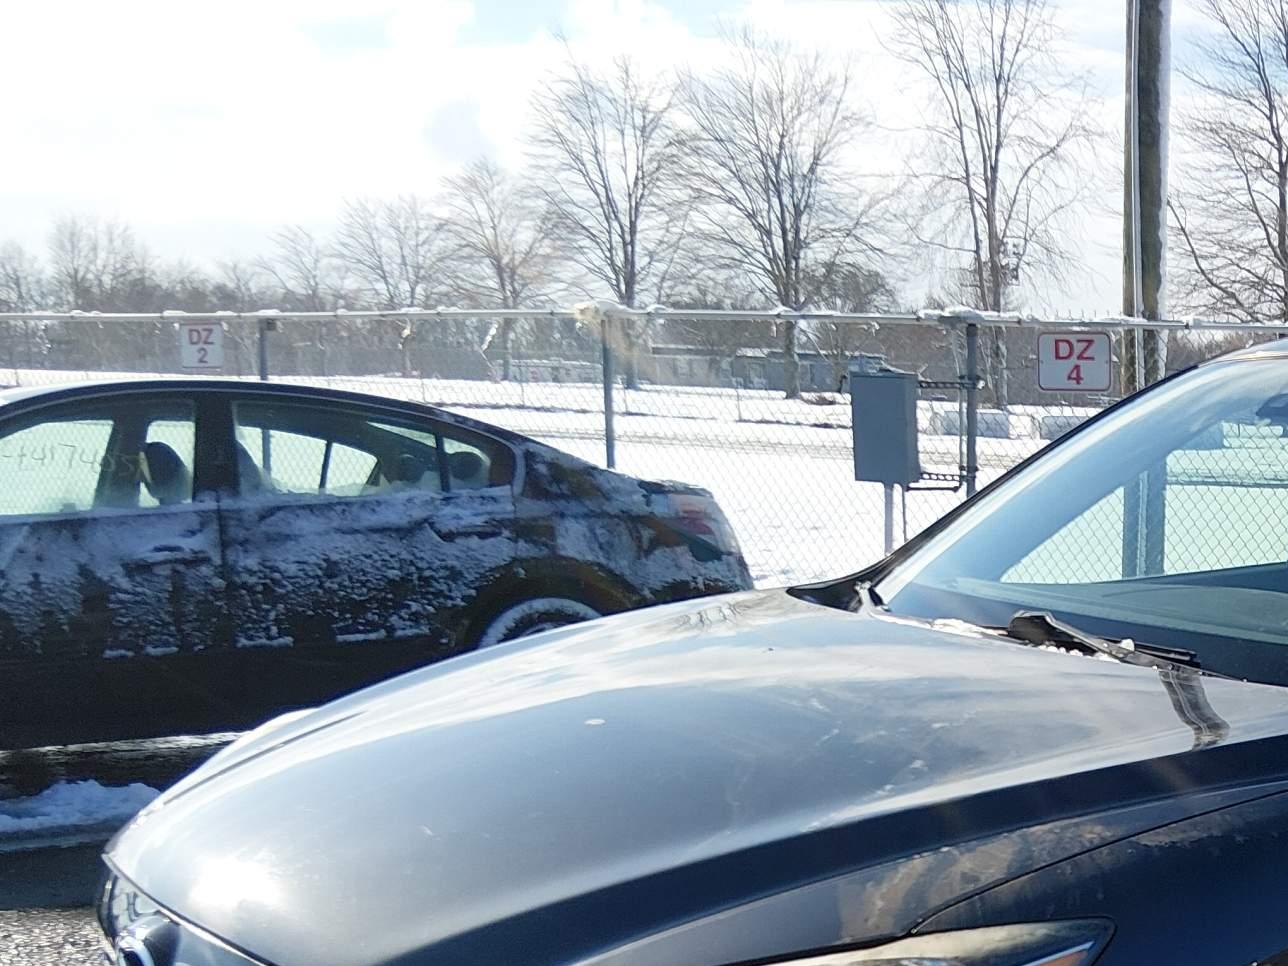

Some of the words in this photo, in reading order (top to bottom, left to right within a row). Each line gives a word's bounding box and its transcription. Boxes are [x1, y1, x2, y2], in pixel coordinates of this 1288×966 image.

[188, 328, 214, 345] DZ
[197, 347, 209, 364] 2
[1054, 338, 1096, 361] DZ
[1066, 363, 1084, 385] 4
